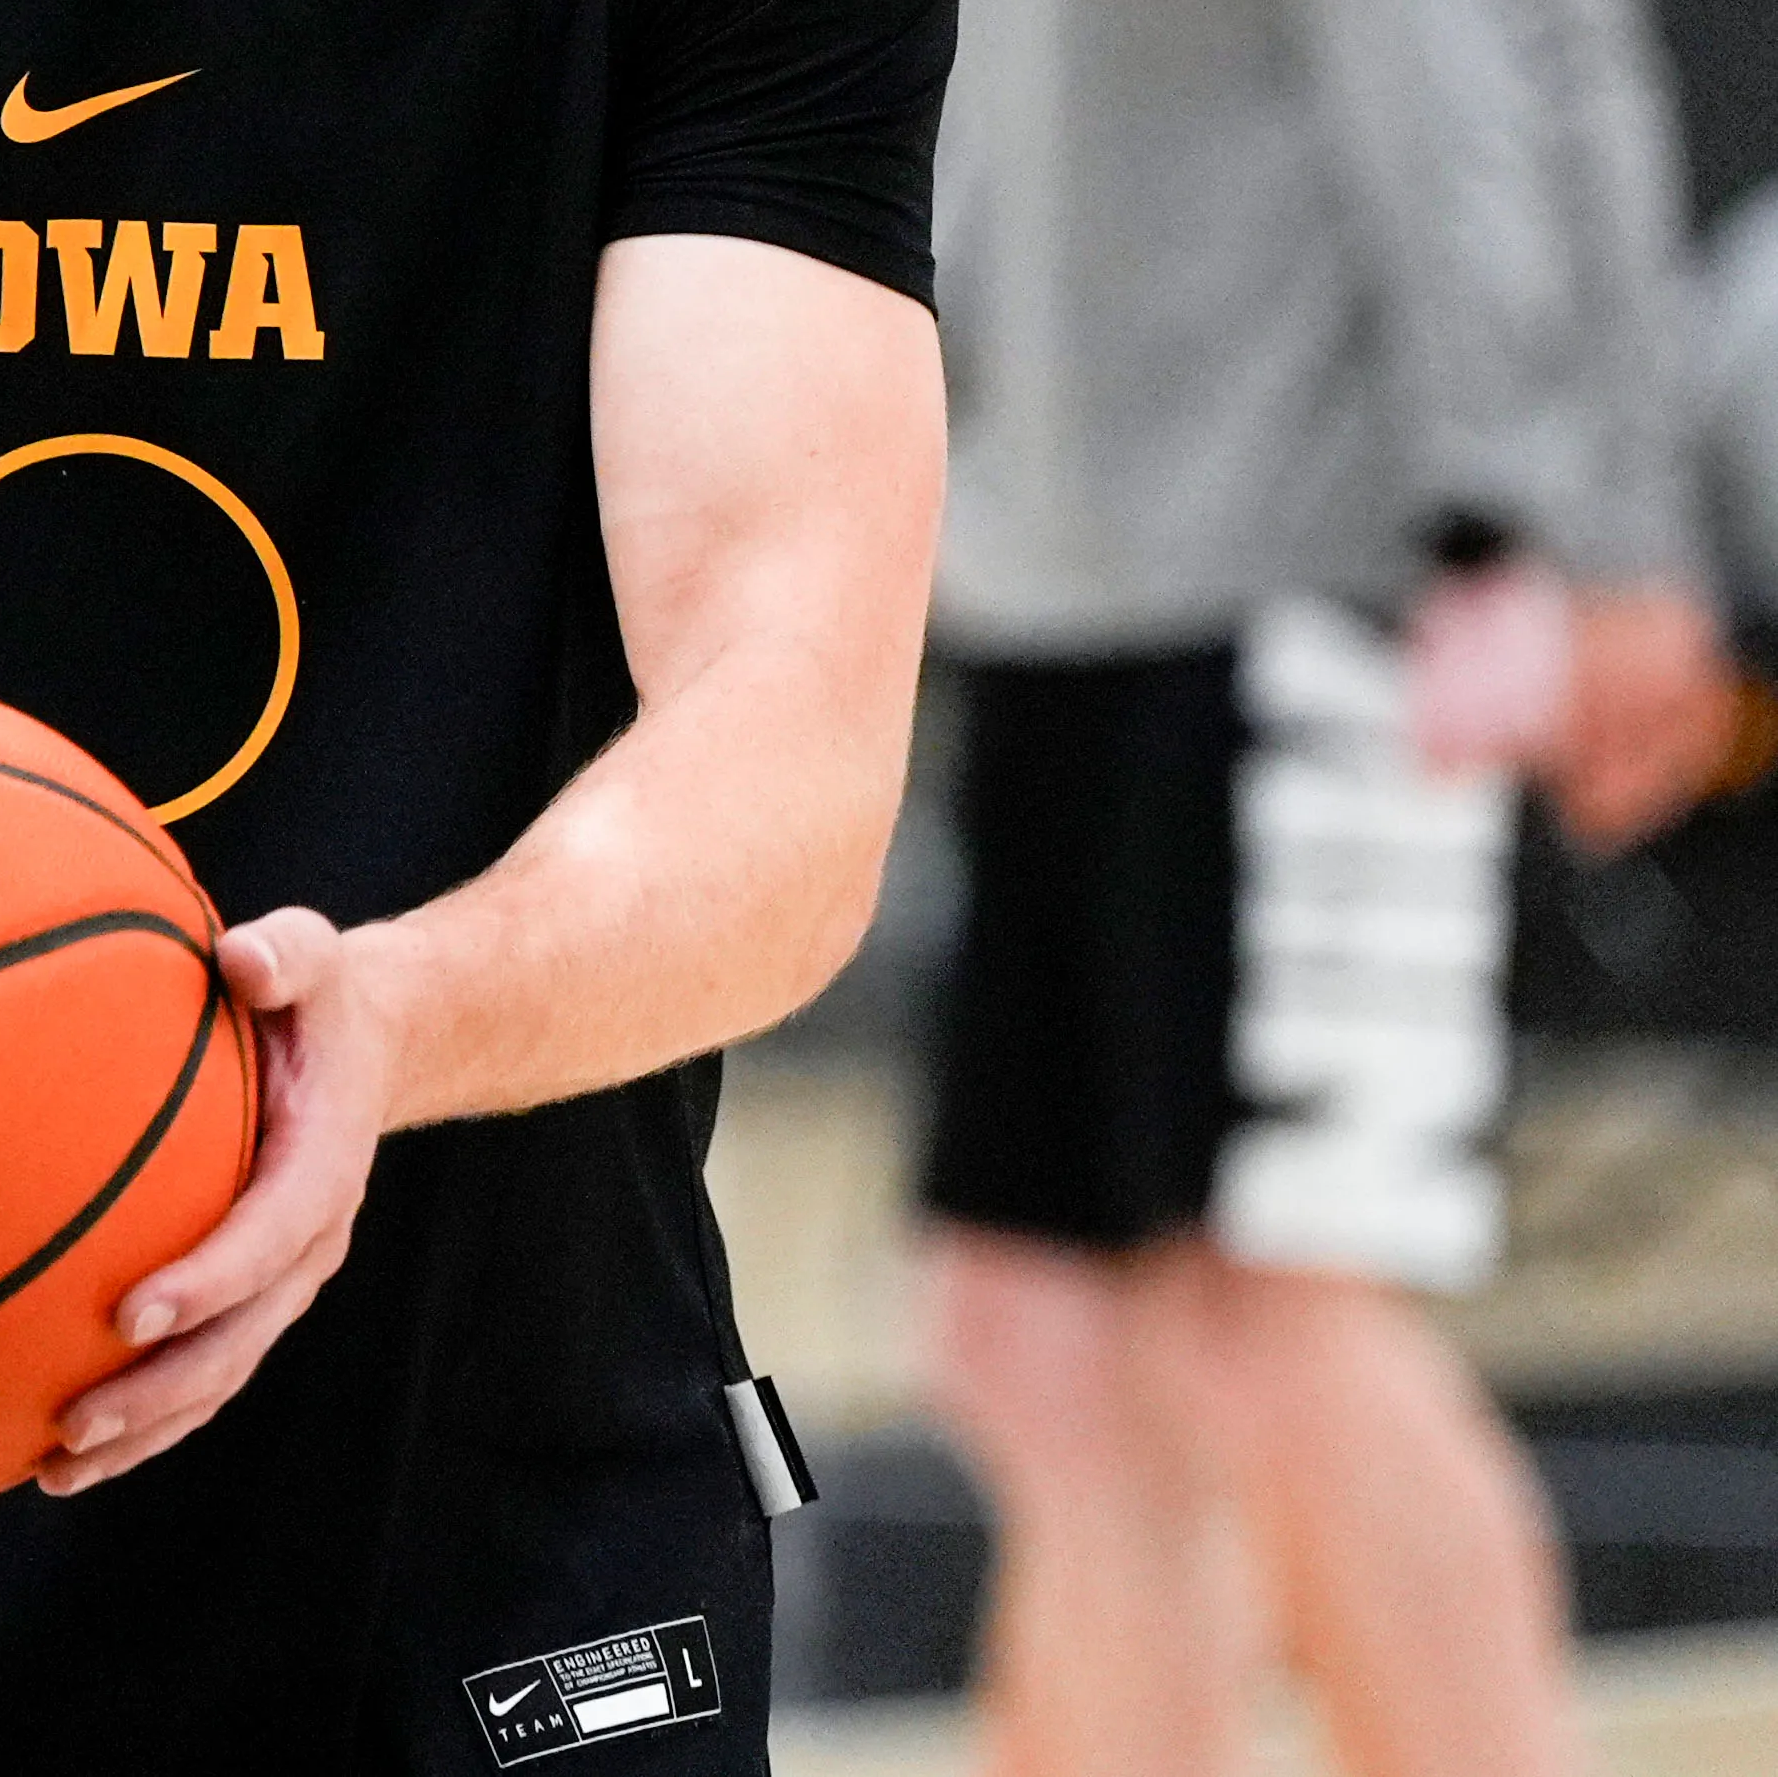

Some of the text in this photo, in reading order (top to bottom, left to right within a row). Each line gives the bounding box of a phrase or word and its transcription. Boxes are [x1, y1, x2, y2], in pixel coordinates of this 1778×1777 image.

[552, 1637, 651, 1674] ENGINEERED
[682, 1648, 703, 1688] L
[498, 1713, 564, 1743] TEAM
